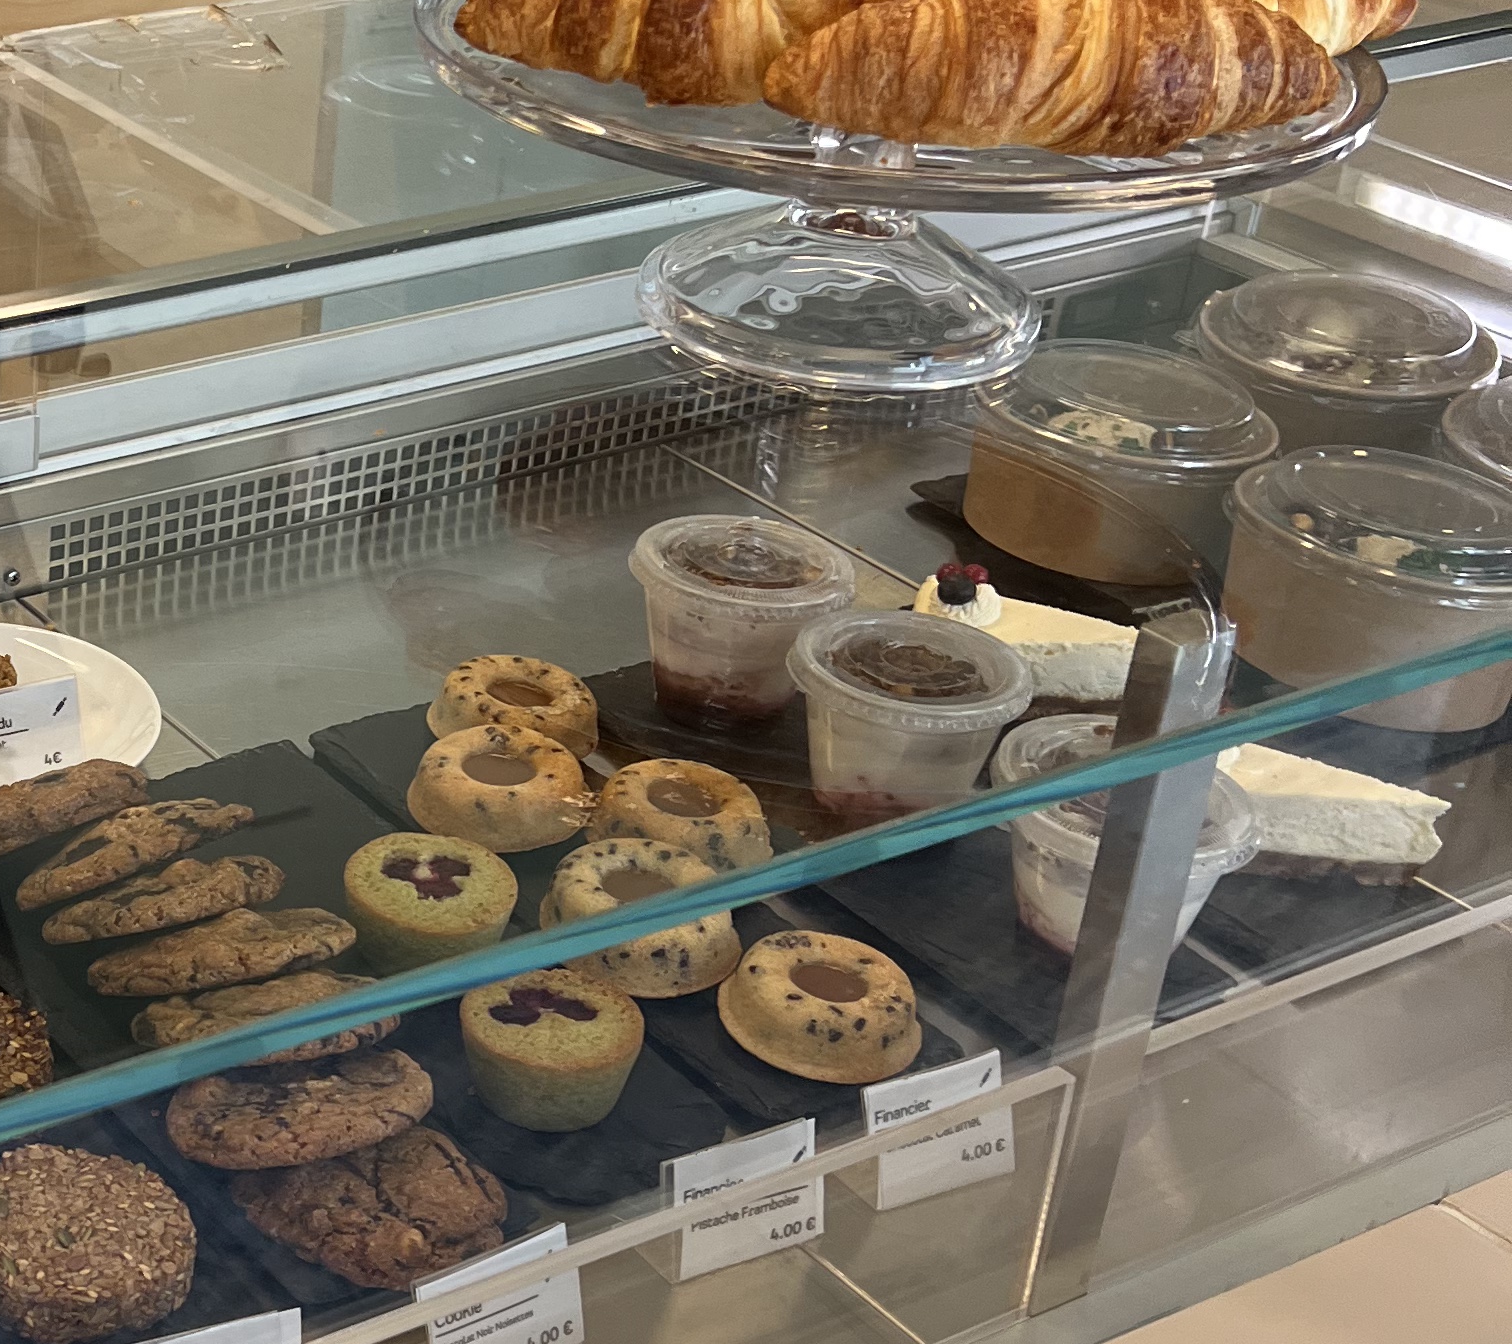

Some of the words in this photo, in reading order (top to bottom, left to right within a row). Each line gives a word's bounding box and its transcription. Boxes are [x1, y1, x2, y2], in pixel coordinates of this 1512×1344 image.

[874, 1099, 932, 1125] Financier
[961, 1142, 992, 1162] 4.00
[995, 1138, 1006, 1153] €
[741, 1193, 800, 1219] Framboise
[770, 1221, 802, 1241] 4.00
[805, 1216, 816, 1231] €
[476, 1325, 495, 1340] Noir
[495, 1309, 535, 1332] Noisettes
[563, 1320, 574, 1336] €
